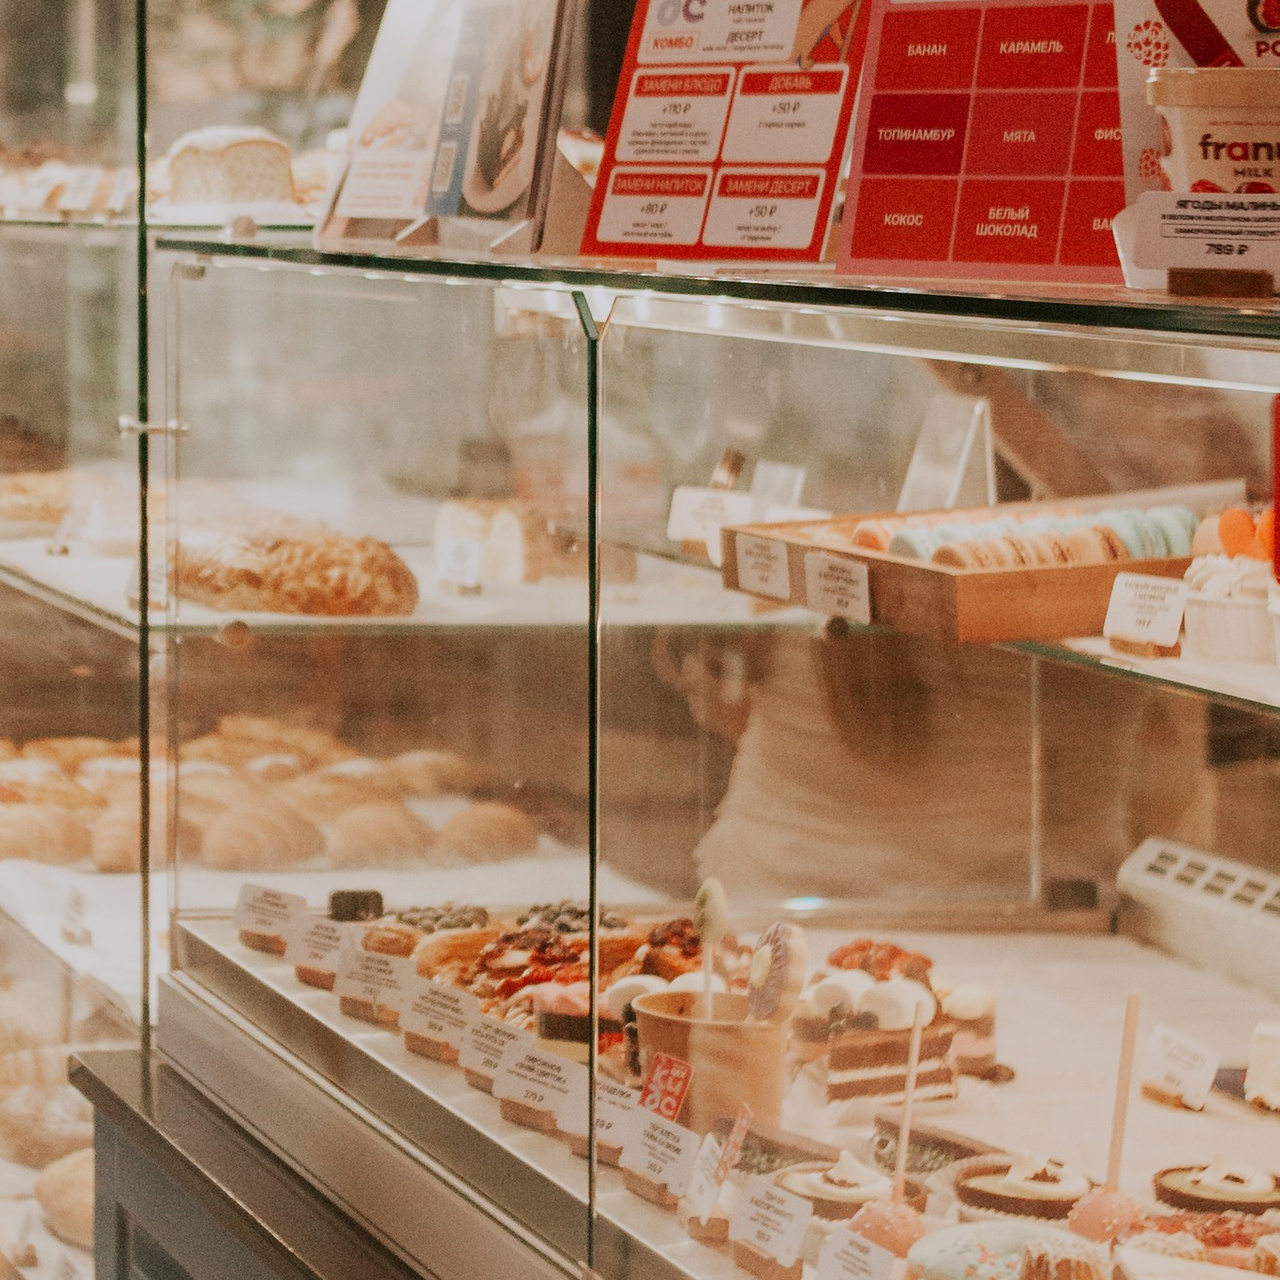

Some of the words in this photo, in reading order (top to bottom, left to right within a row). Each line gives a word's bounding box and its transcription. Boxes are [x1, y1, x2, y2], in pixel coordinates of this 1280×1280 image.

[728, 3, 775, 16] НАПИТОК
[652, 35, 694, 50] КОМБО
[726, 31, 764, 45] ДЕСЕРТ
[908, 44, 947, 56] БАНАН
[999, 40, 1064, 54] КАРАМЕЛЬ
[642, 79, 682, 92] ЗАМЕНИ
[683, 78, 722, 92] БЛЮДО
[771, 76, 812, 91] ДОБАВЬ
[877, 129, 955, 141] ТОПИНАМБУР
[1003, 131, 1036, 143] МЯТА
[1094, 129, 1122, 141] ФИС
[616, 179, 656, 191] ЗАМЕНИ
[657, 180, 703, 193] НАПИТОК
[726, 180, 769, 193] ЗАМЕНИ
[770, 181, 811, 194] ДЕСЕРТ
[749, 205, 768, 217] +50
[988, 207, 1030, 220] БЕЛЫЙ
[884, 213, 923, 226] КОКОС
[976, 224, 1038, 239] ШОКОЛАД
